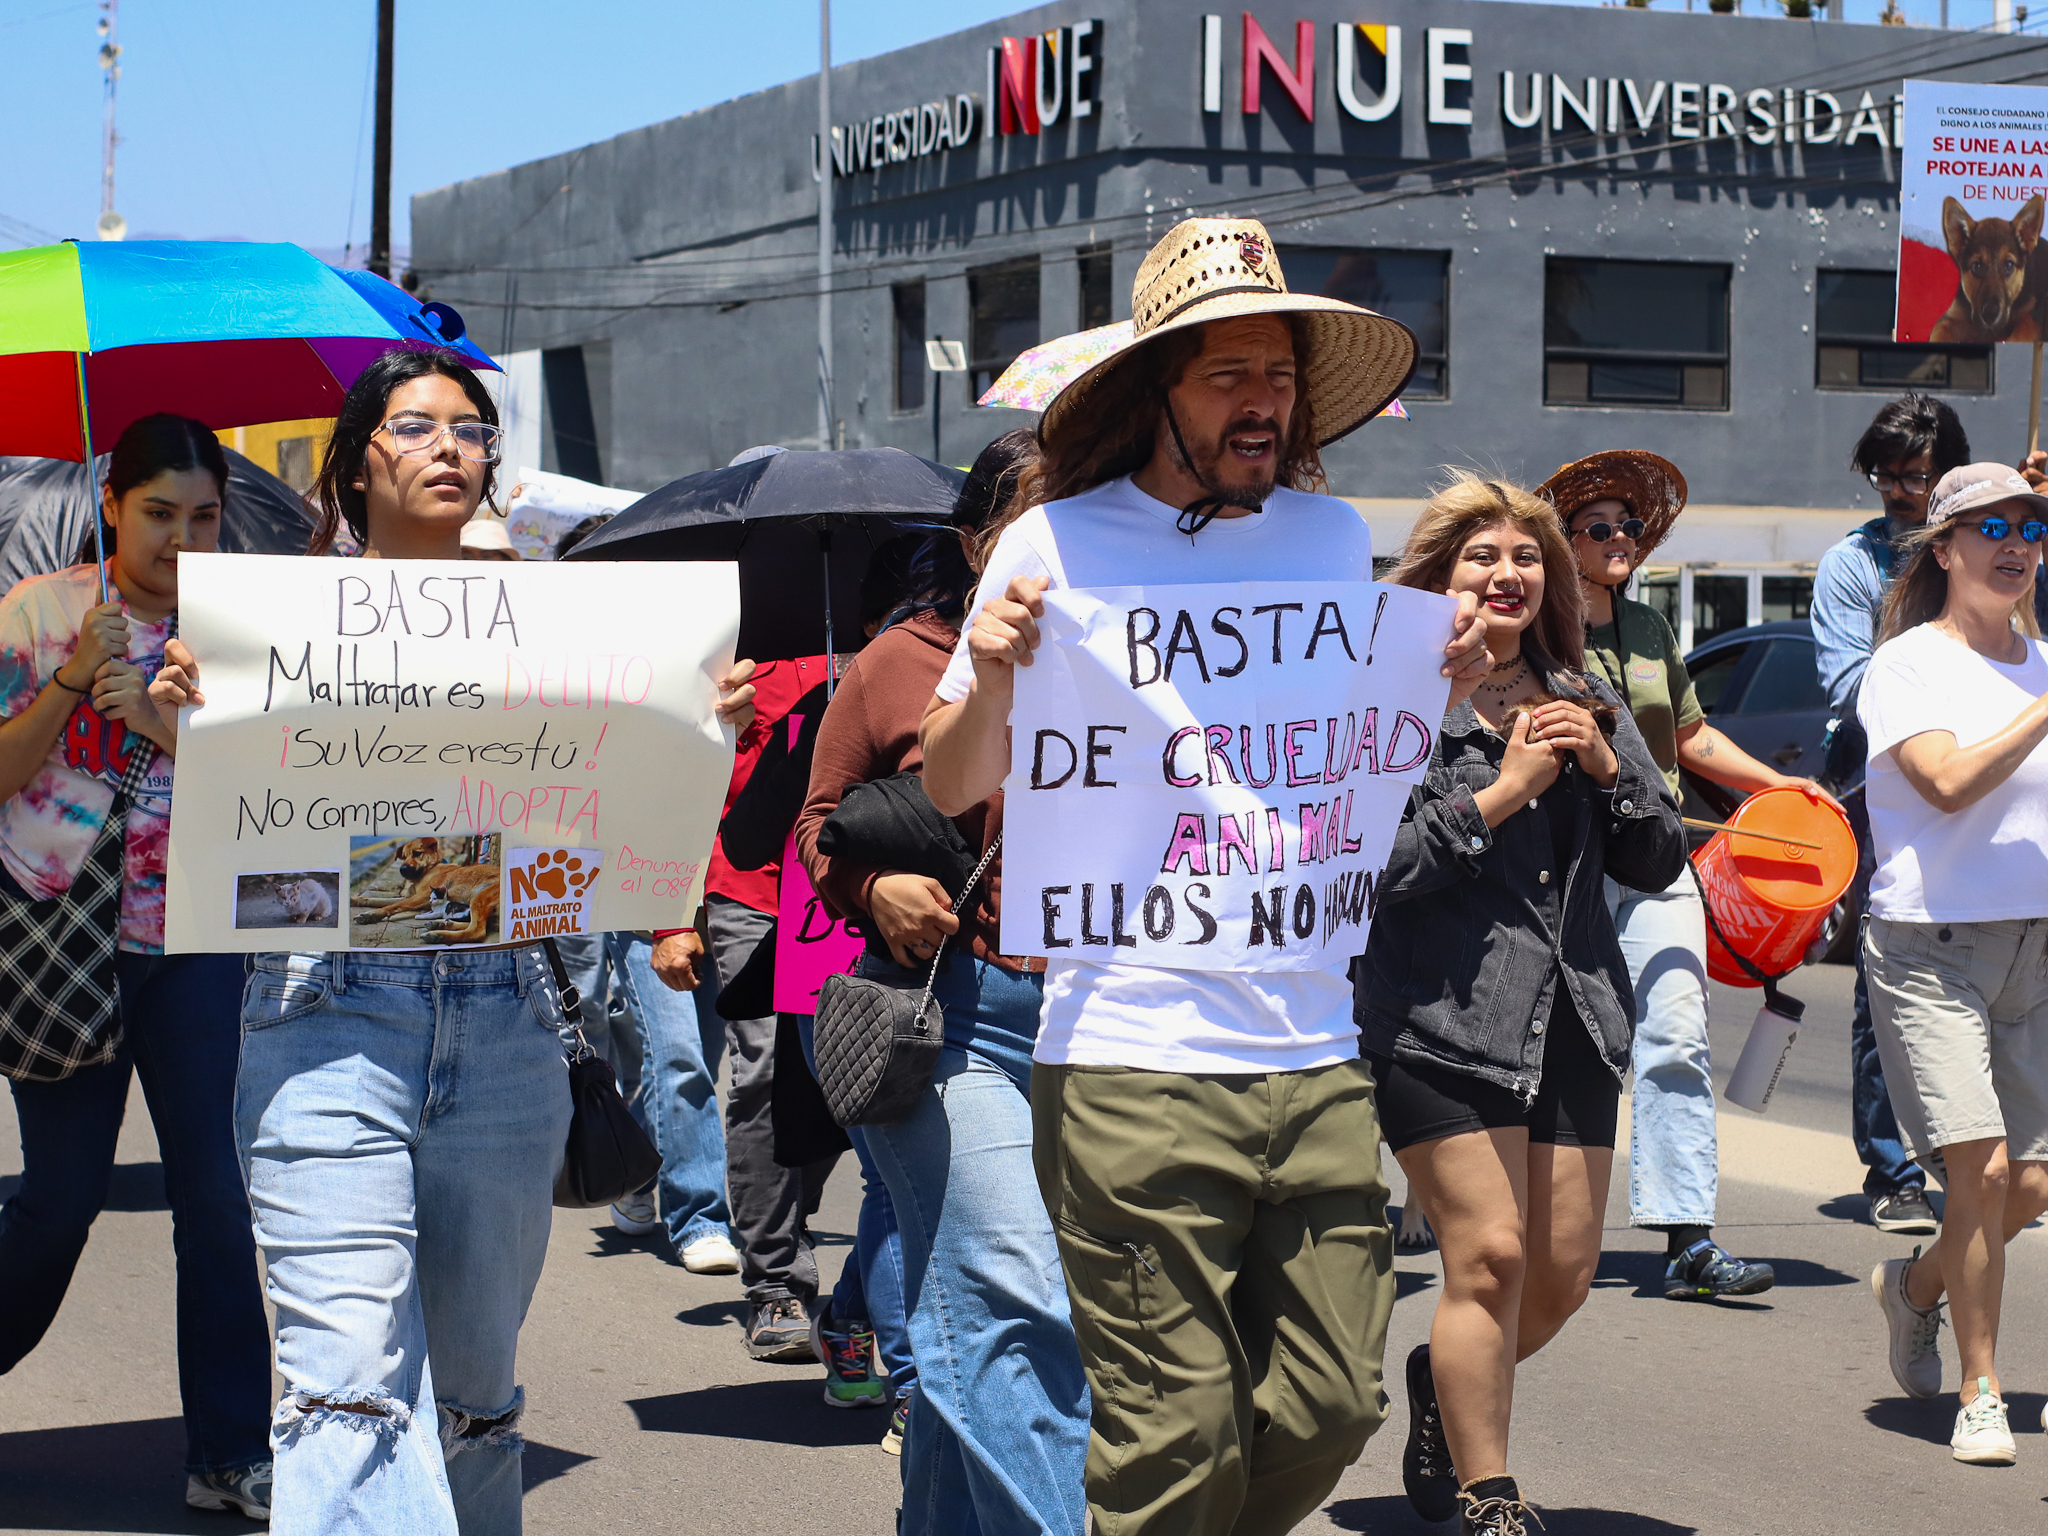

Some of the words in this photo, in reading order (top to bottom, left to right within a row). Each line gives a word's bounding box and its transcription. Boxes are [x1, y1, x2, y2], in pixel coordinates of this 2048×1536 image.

[986, 19, 1094, 138] INUE
[1204, 11, 1473, 125] INUE
[1936, 106, 1946, 115] EL
[1948, 107, 1990, 116] CONSEJO
[1991, 108, 2045, 118] CIUDADANO
[1940, 119, 1971, 128] DIGNO
[1972, 120, 1979, 128] A
[1980, 121, 1997, 129] LOS
[1998, 122, 2043, 131] ANIMALES
[1932, 136, 1955, 152] SE
[1960, 137, 1999, 154] UNE
[2003, 139, 2017, 155] A
[1926, 160, 2025, 178] PROTEJAN
[2029, 163, 2043, 179] A
[1963, 184, 1987, 200] DE
[337, 568, 519, 647] BASTA
[1127, 591, 1388, 689] BASTA!
[263, 640, 438, 713] Maltratar
[447, 681, 485, 709] es
[502, 653, 653, 710] DELITO
[1029, 725, 1127, 790] DE
[146, 775, 174, 788] 198
[450, 775, 600, 840] ADOPTA
[1160, 789, 1363, 876] ANIMAL
[616, 845, 701, 875] Denuncia
[620, 876, 642, 893] al
[651, 876, 694, 898] 089
[510, 907, 526, 919] AL
[527, 902, 582, 918] MALTRATO
[510, 914, 582, 940] ANIMAL
[1041, 881, 1218, 949] ELLOS
[1247, 883, 1316, 951] NO
[1762, 1045, 1792, 1105] Columbia
